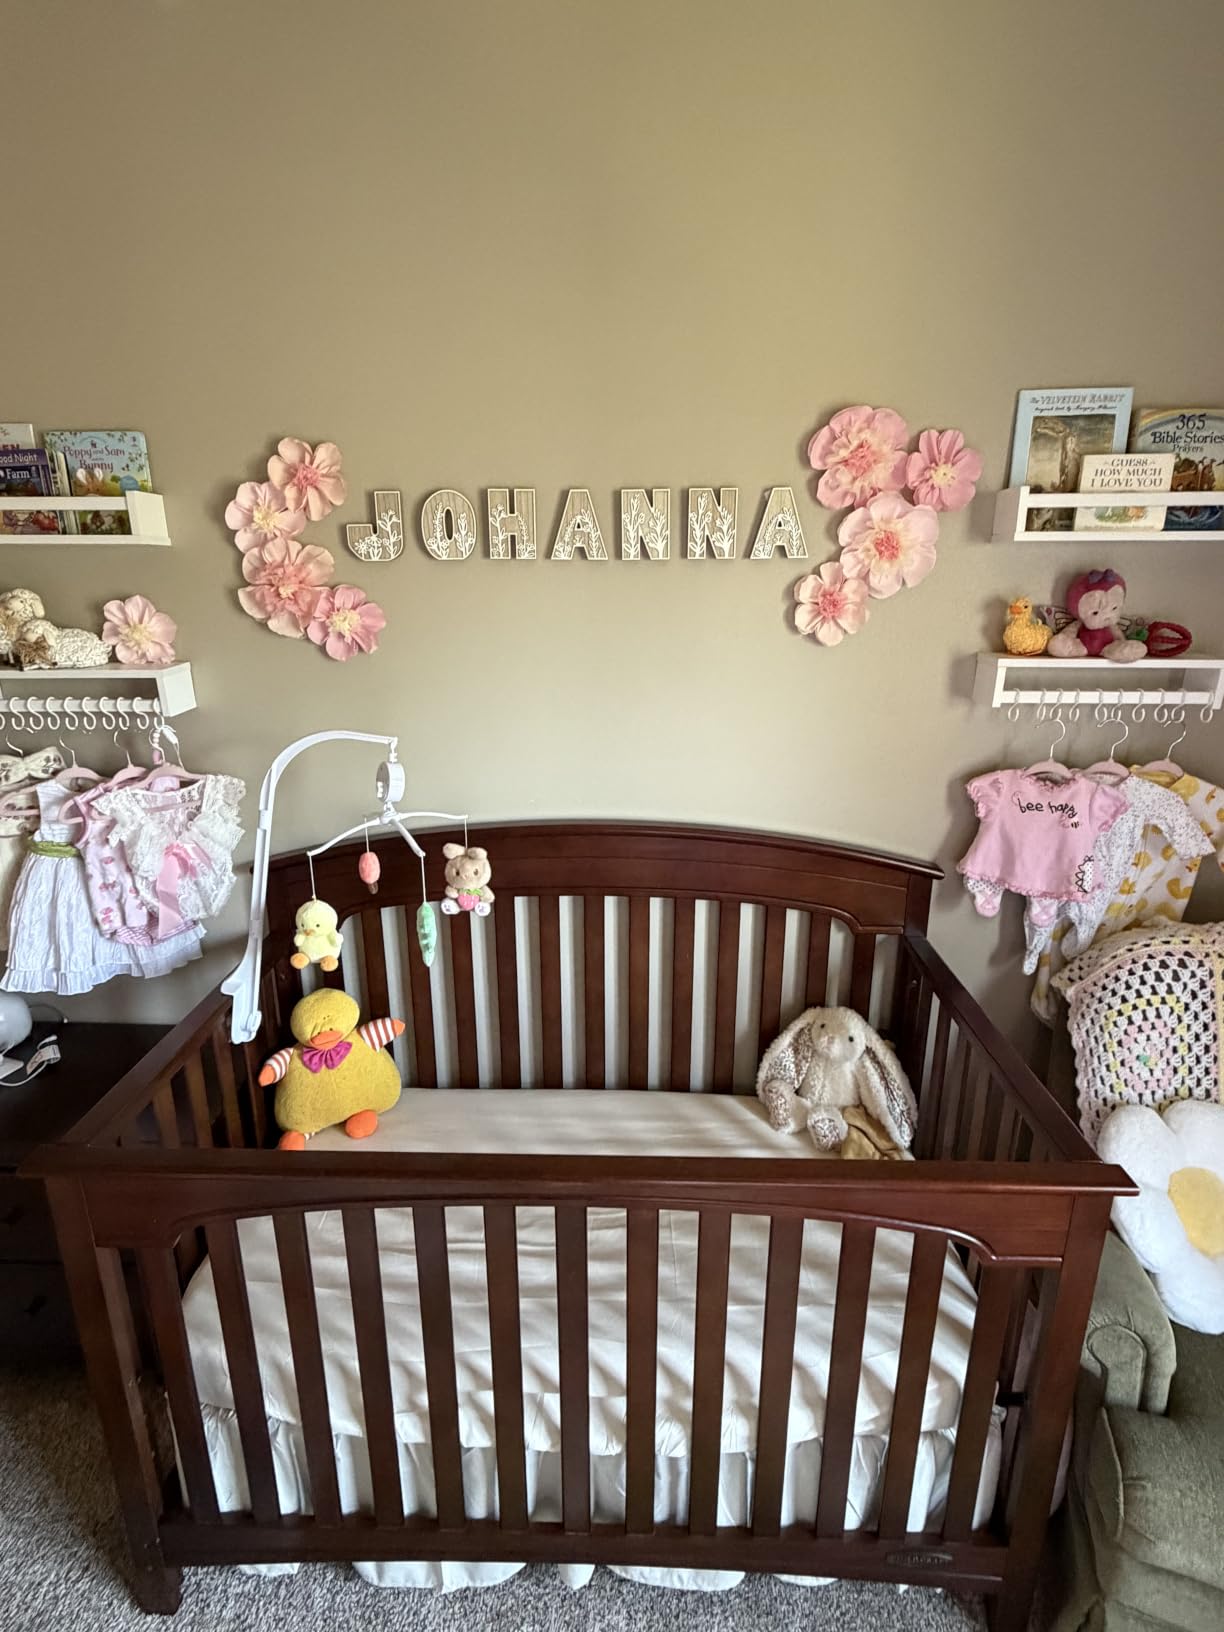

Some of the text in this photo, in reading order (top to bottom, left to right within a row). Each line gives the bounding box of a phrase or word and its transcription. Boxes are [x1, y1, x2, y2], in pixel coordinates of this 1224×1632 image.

[1176, 413, 1207, 430] 365
[1151, 430, 1182, 444] Bible
[63, 445, 92, 458] Poppy
[104, 444, 126, 457] Sam
[1173, 443, 1204, 454] Prayers
[14, 452, 38, 465] Night
[1111, 458, 1149, 467] GUESS
[80, 459, 114, 473] Bunny
[1095, 467, 1162, 477] HOW MUCH
[5, 468, 30, 480] Farm
[1091, 477, 1163, 487] I LOVE YOU
[346, 487, 809, 562] JOHANNA
[1017, 797, 1078, 819] bee happy
